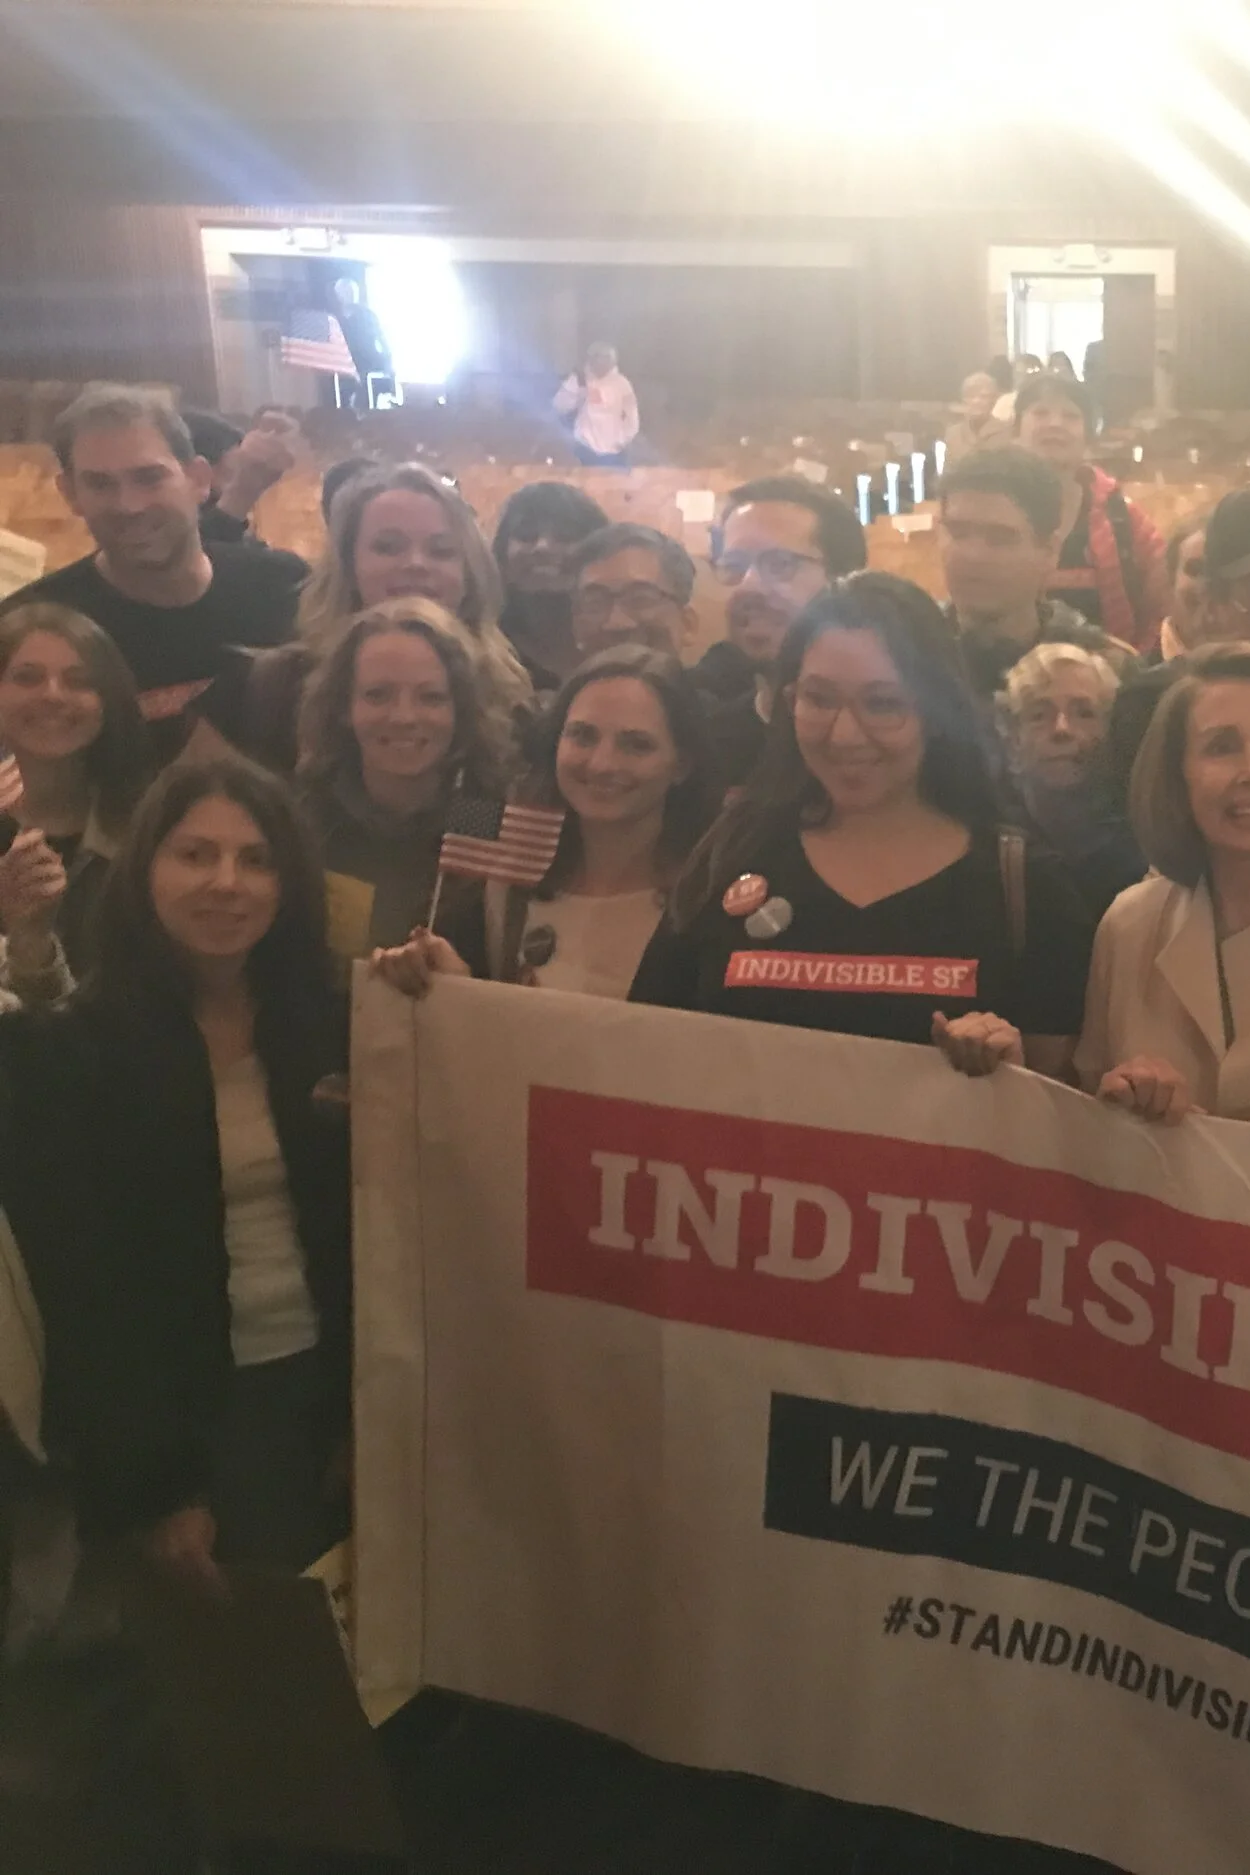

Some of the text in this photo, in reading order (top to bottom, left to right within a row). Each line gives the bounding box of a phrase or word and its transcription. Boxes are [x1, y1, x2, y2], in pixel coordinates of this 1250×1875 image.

[736, 957, 970, 990] INDIVISIBLE SF
[829, 1436, 949, 1519] WE
[973, 1455, 1119, 1556] THE
